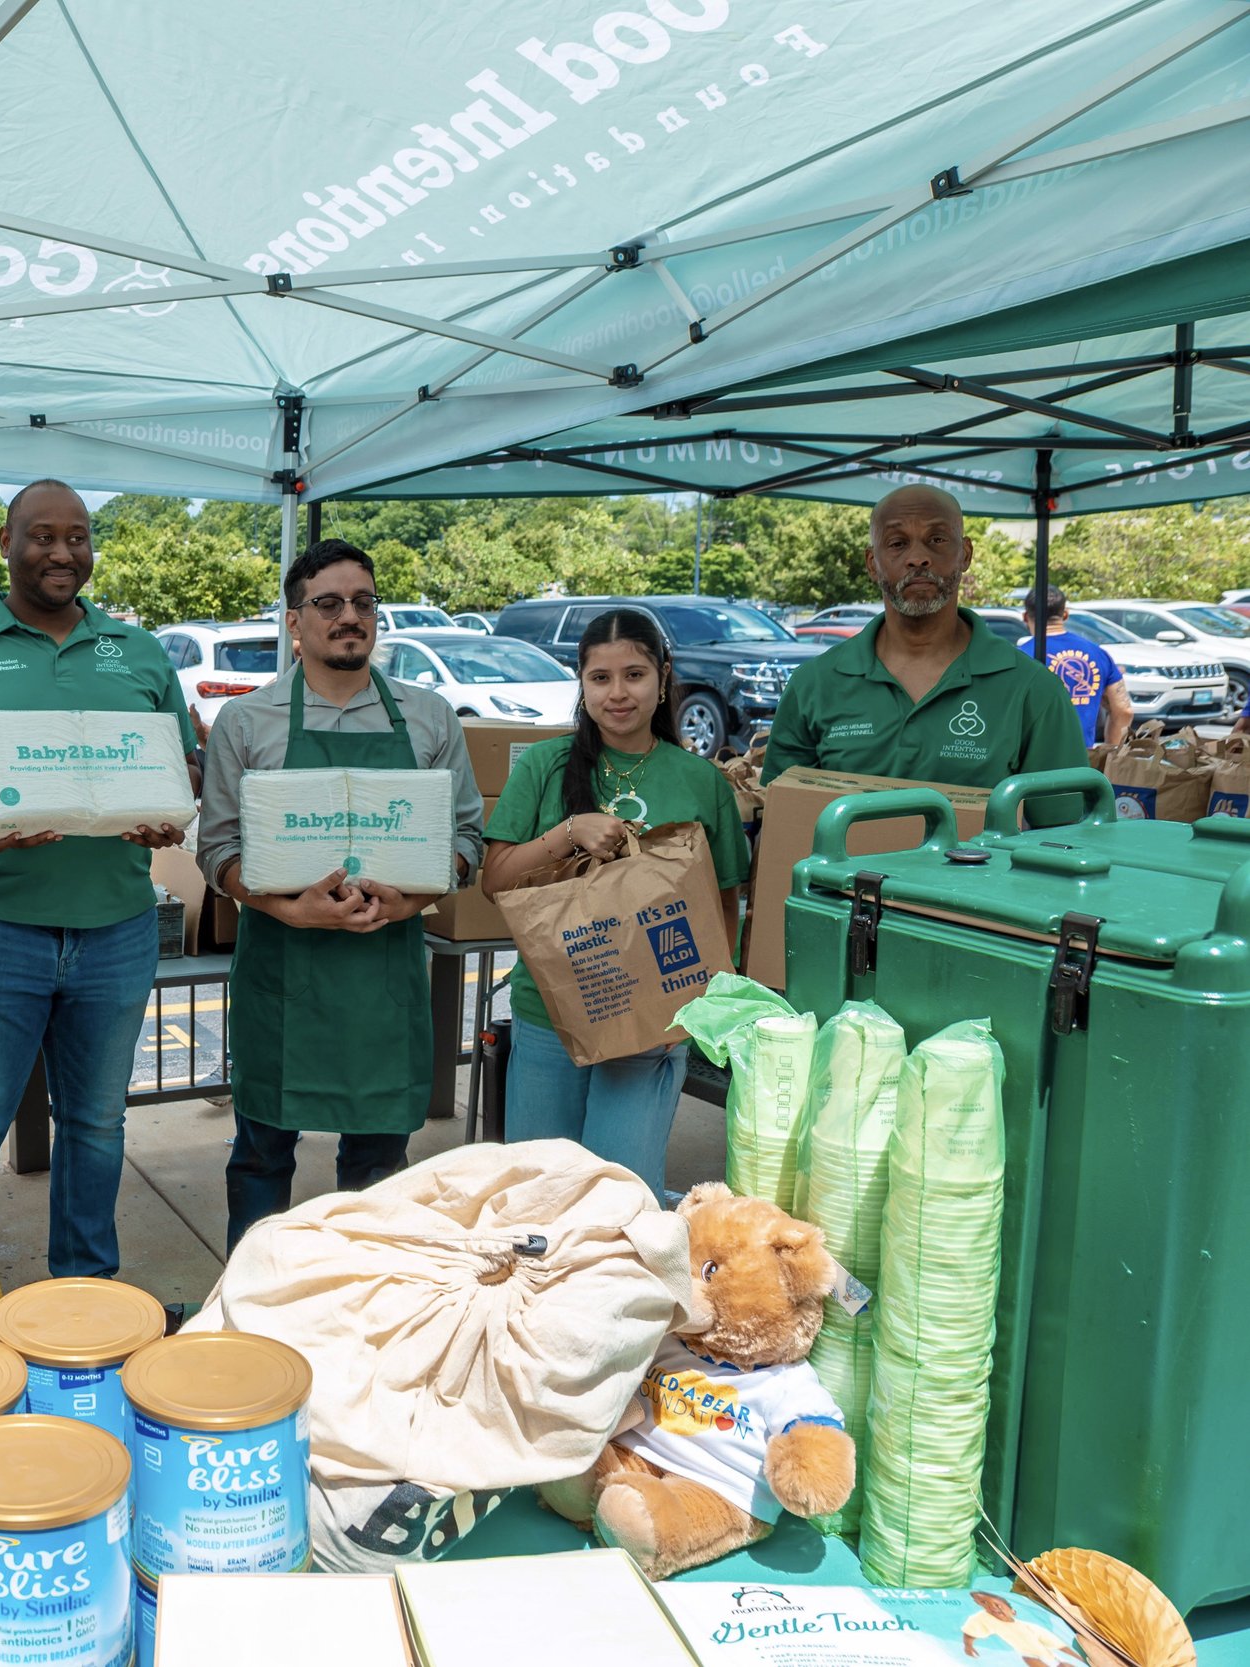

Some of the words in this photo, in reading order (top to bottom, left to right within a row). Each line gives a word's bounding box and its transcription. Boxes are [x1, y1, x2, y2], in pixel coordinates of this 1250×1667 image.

[942, 745, 988, 754] INTENTIONS
[954, 739, 976, 747] GOOD
[16, 745, 131, 763] Baby2Baby
[940, 751, 988, 760] FOUNDATION
[9, 765, 41, 773] Providing
[284, 812, 395, 832] Baby2Baby
[275, 834, 306, 842] Providing
[365, 835, 383, 843] every
[636, 908, 662, 926] It's
[665, 900, 687, 917] an
[562, 917, 621, 942] Buh-bye,
[566, 934, 612, 958] plastic.
[571, 957, 587, 968] ALDI
[594, 949, 620, 961] leading
[663, 948, 694, 967] ALDI
[574, 966, 585, 975] the
[586, 964, 601, 973] way
[577, 966, 623, 984] sustainability.
[579, 983, 589, 991] We
[590, 980, 602, 988] are
[603, 977, 614, 986] the
[615, 972, 630, 982] first
[582, 989, 601, 1001] major
[615, 978, 640, 991] retailer
[661, 969, 713, 994] thing.
[584, 1000, 592, 1008] to
[611, 989, 633, 1003] plastic
[586, 1006, 603, 1017] bags
[604, 1002, 621, 1012] from
[589, 1016, 598, 1024] of
[598, 1012, 610, 1021] our
[611, 1006, 633, 1018] stores.
[75, 1373, 102, 1381] MONTHS
[188, 1439, 279, 1468] Pure
[187, 1465, 282, 1493] Bliss
[203, 1497, 221, 1511] by
[225, 1486, 282, 1508] Similac
[268, 1504, 285, 1517] Non
[185, 1523, 201, 1533] No
[203, 1523, 257, 1535] antibiotics
[222, 1537, 245, 1549] AFTER
[271, 1528, 286, 1540] MILK
[188, 1563, 214, 1573] IMMUNE
[0, 1603, 20, 1620] by
[25, 1595, 92, 1618] Similac
[731, 1605, 772, 1615] mama
[774, 1604, 806, 1613] bear
[75, 1613, 96, 1627] Non
[709, 1617, 823, 1644] Gentle
[816, 1613, 920, 1634] Touch
[0, 1634, 63, 1647] antibiotics
[76, 1625, 96, 1638] GMO
[22, 1648, 48, 1664] AFTER
[50, 1645, 79, 1661] BREAST
[80, 1640, 96, 1653] MILK
